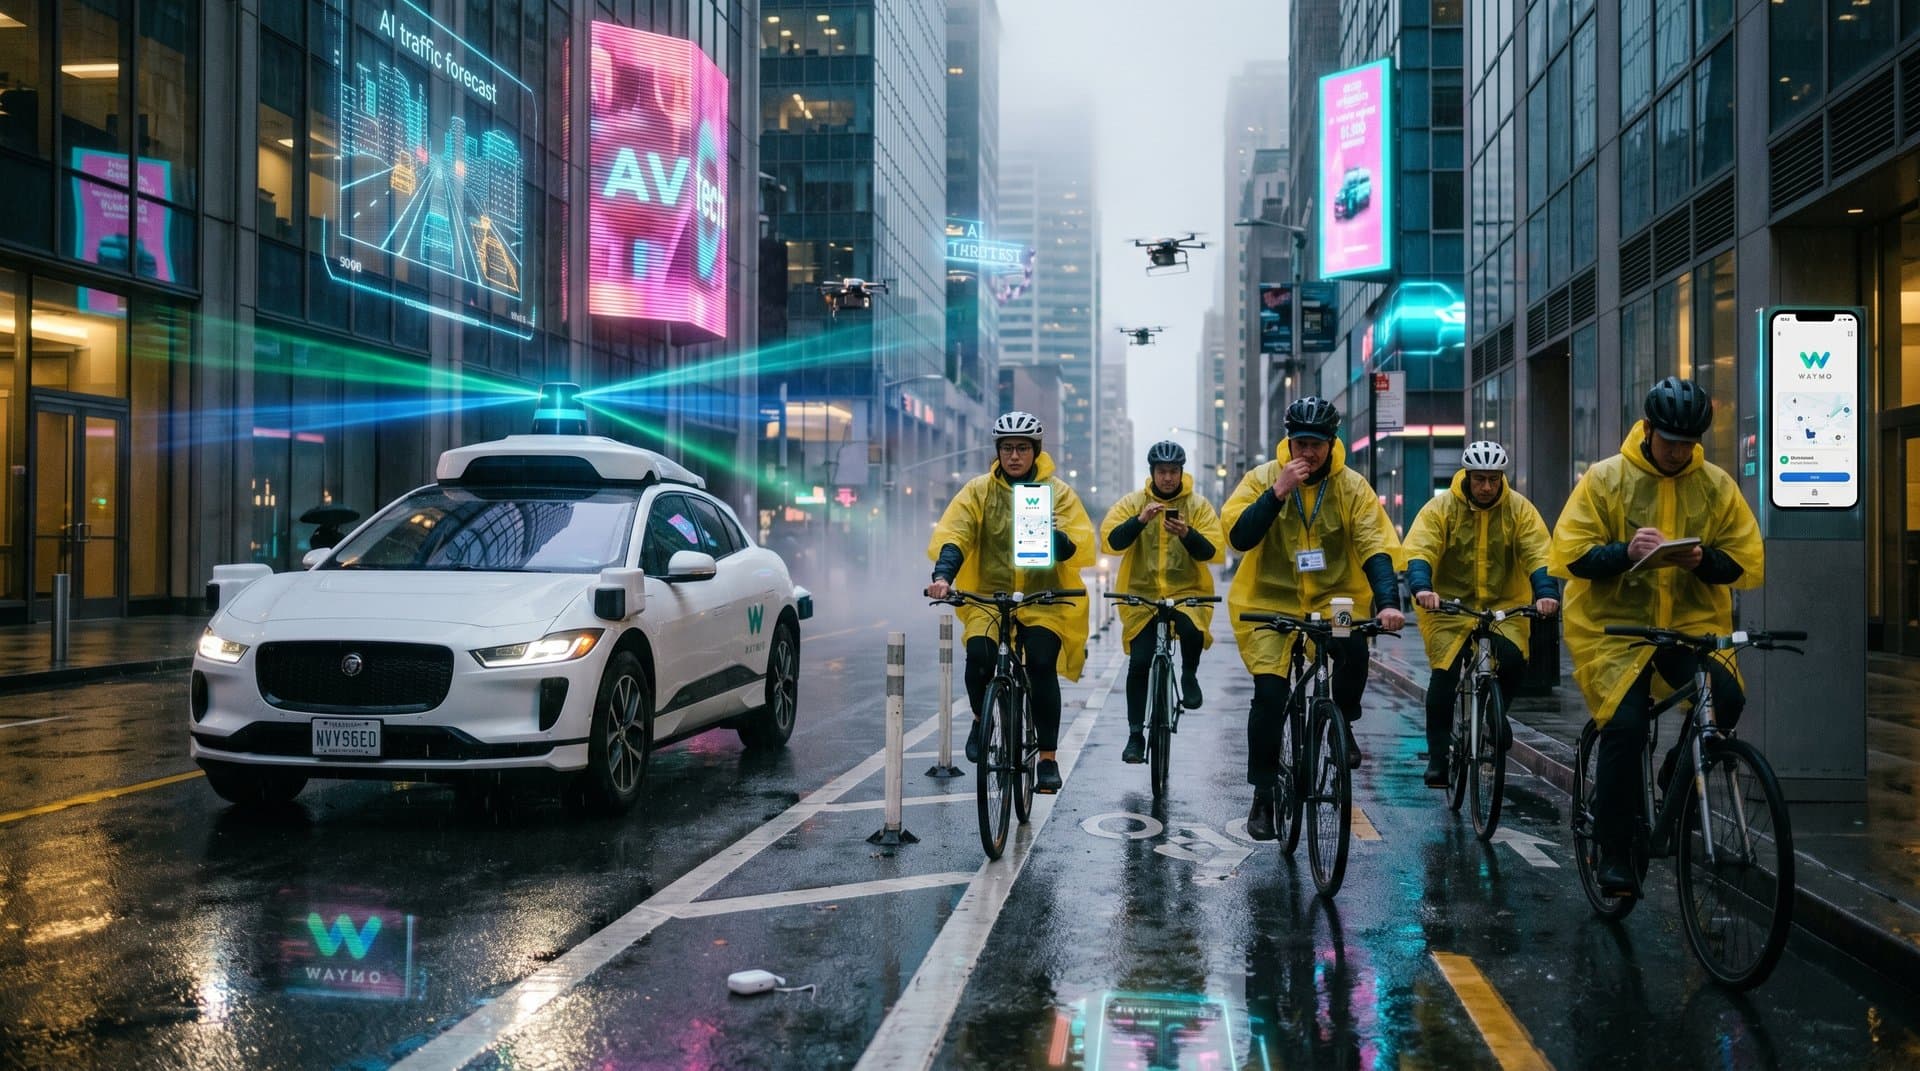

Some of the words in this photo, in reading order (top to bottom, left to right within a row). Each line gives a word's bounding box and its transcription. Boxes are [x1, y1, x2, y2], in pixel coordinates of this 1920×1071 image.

[379, 9, 395, 39] AI
[400, 23, 442, 69] traffic
[445, 52, 497, 105] forecast
[602, 147, 690, 206] AV
[697, 167, 725, 230] tech
